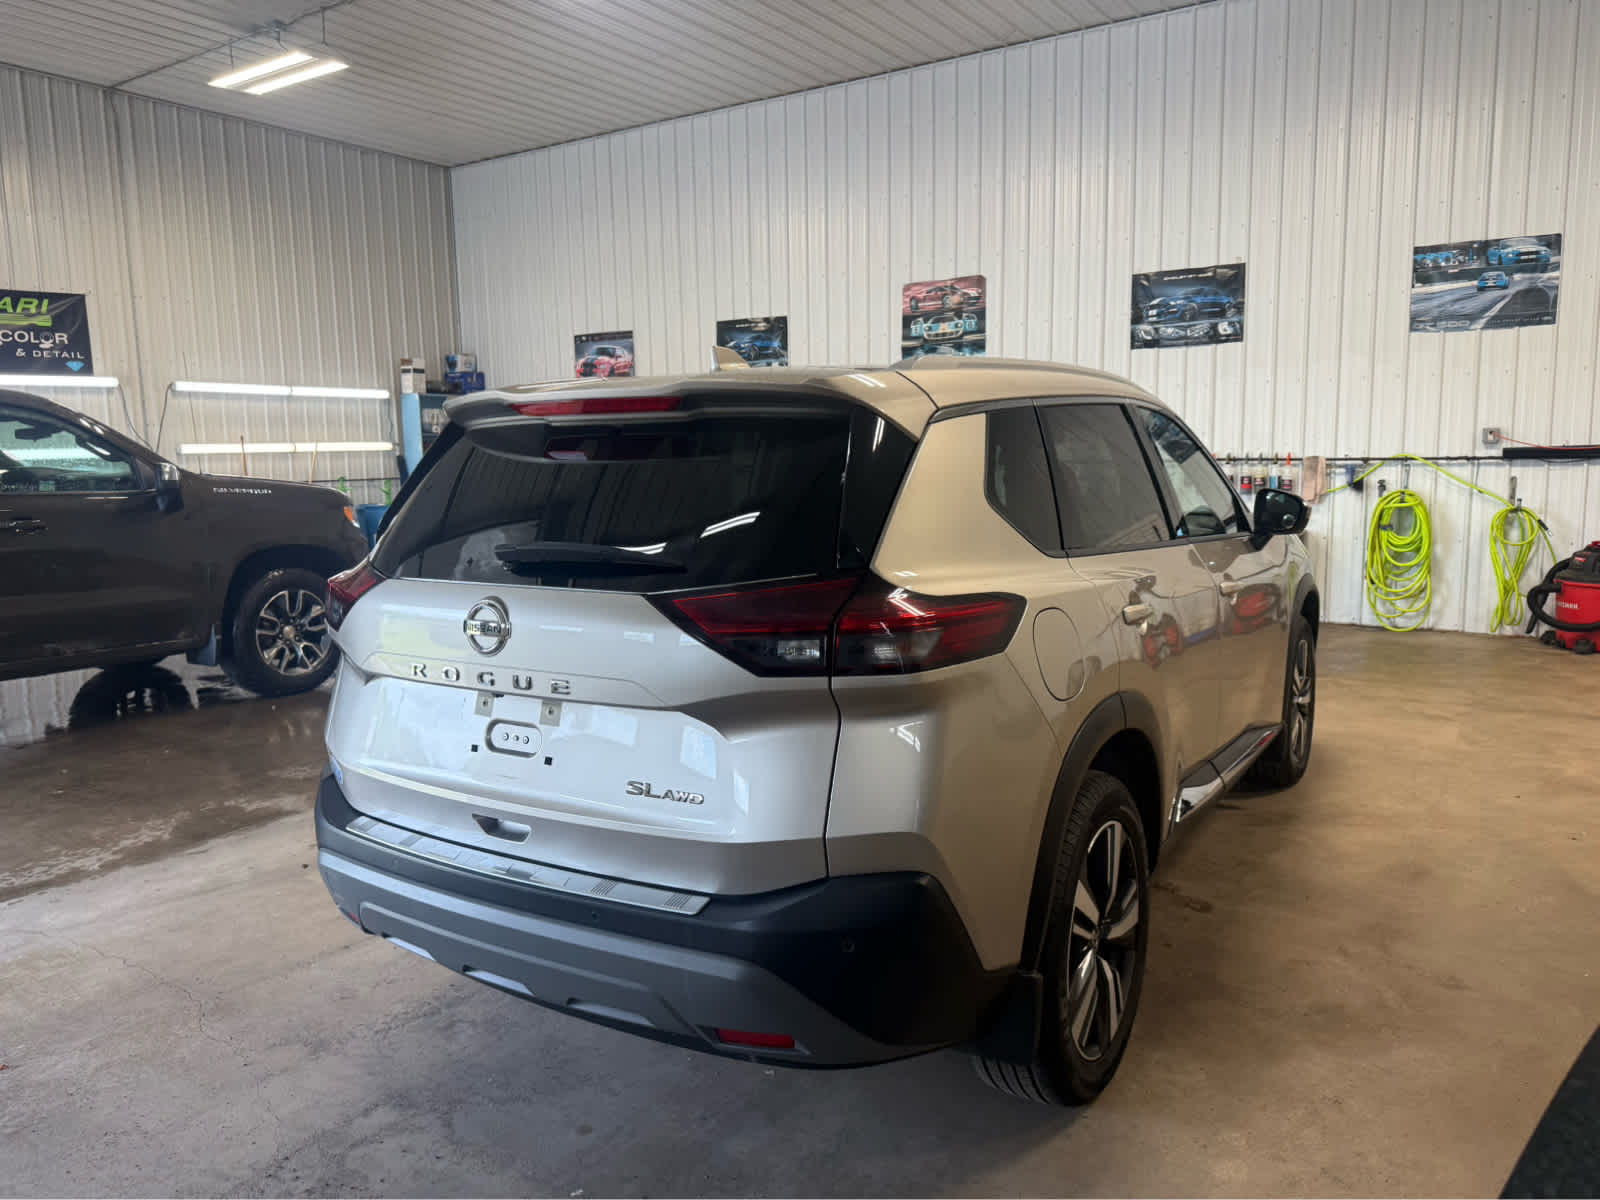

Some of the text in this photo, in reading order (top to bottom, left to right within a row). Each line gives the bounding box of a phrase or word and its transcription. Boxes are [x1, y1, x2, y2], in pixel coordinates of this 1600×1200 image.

[0, 329, 69, 345] COLOR
[16, 348, 85, 359] & DETAIL
[466, 622, 502, 634] NISSAN
[411, 662, 571, 695] ROGUE
